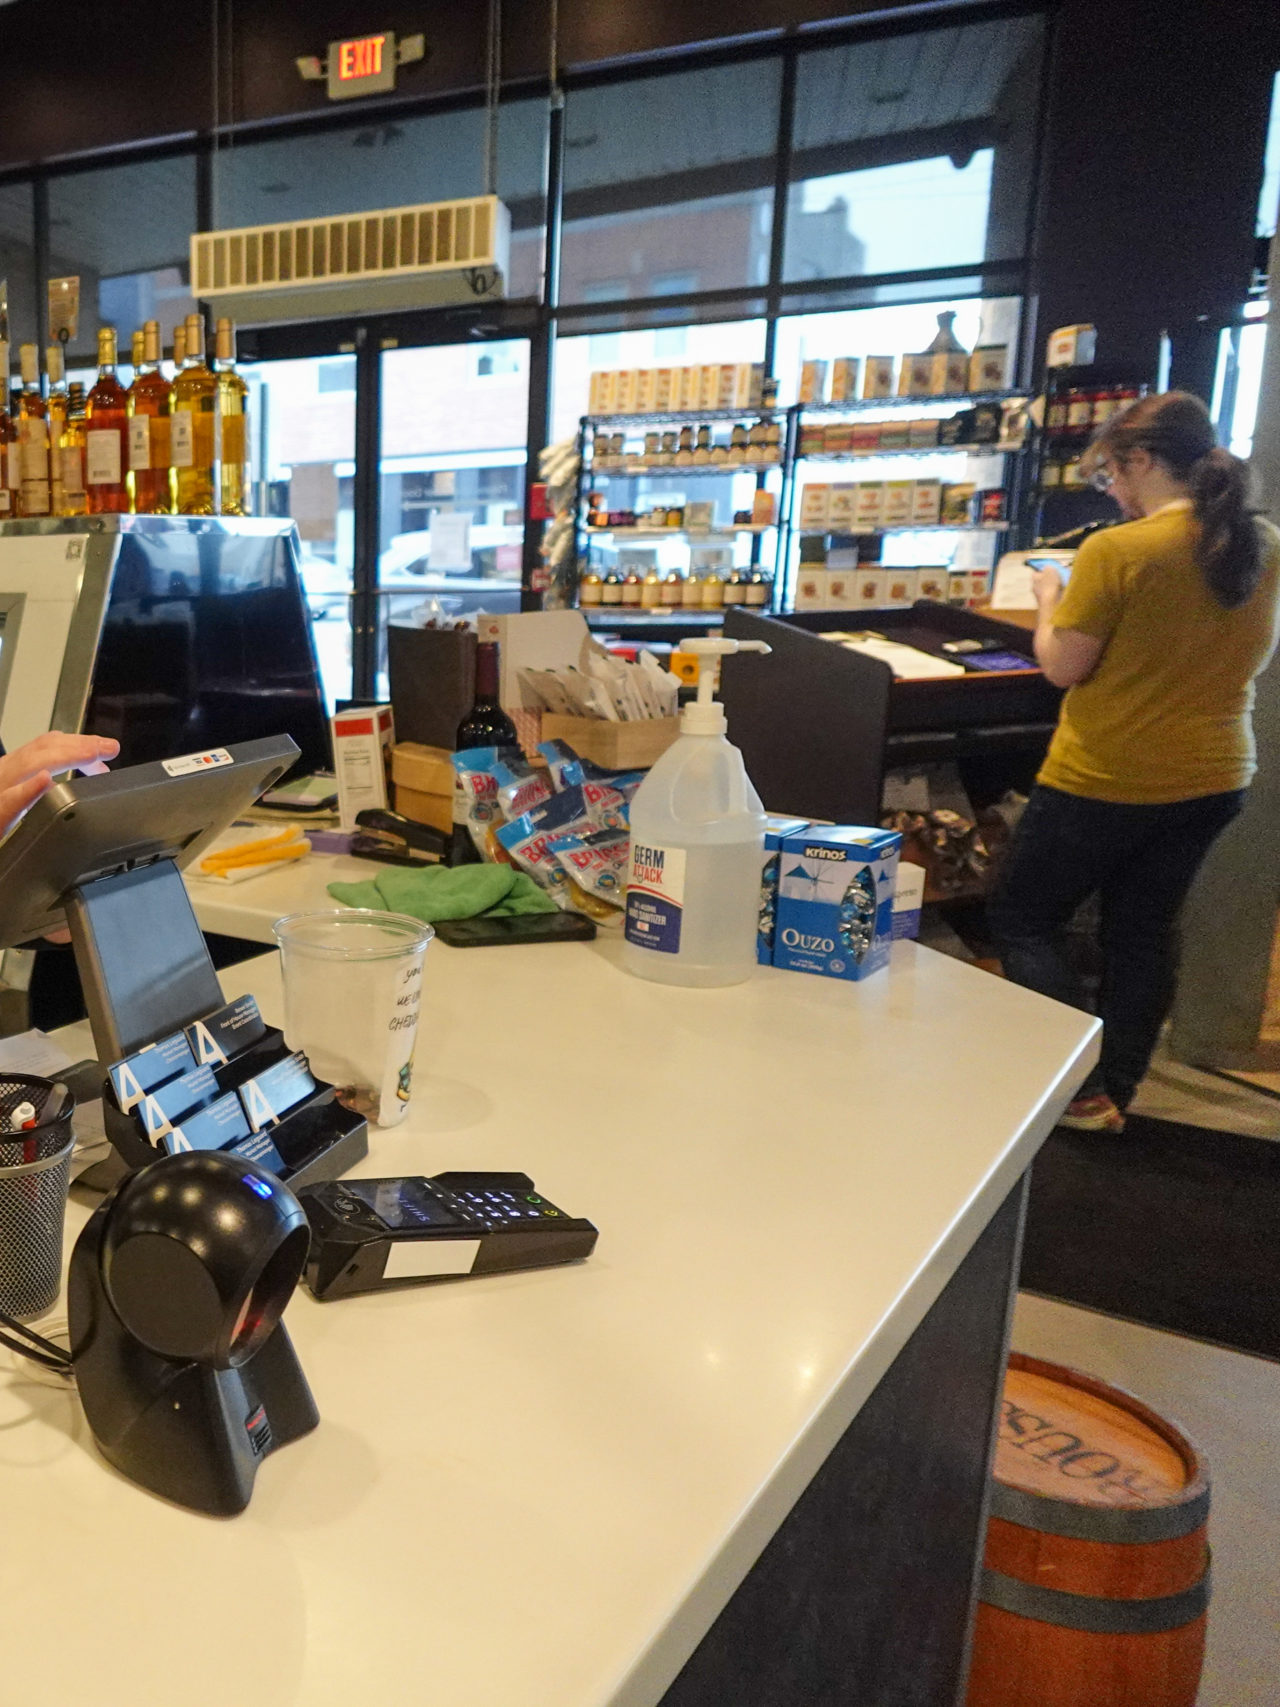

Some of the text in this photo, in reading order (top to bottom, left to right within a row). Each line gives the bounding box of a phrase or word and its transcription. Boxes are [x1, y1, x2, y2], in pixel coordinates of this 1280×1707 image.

[339, 36, 385, 80] EXIT
[634, 844, 665, 869] GERM
[633, 863, 664, 885] ATTACK
